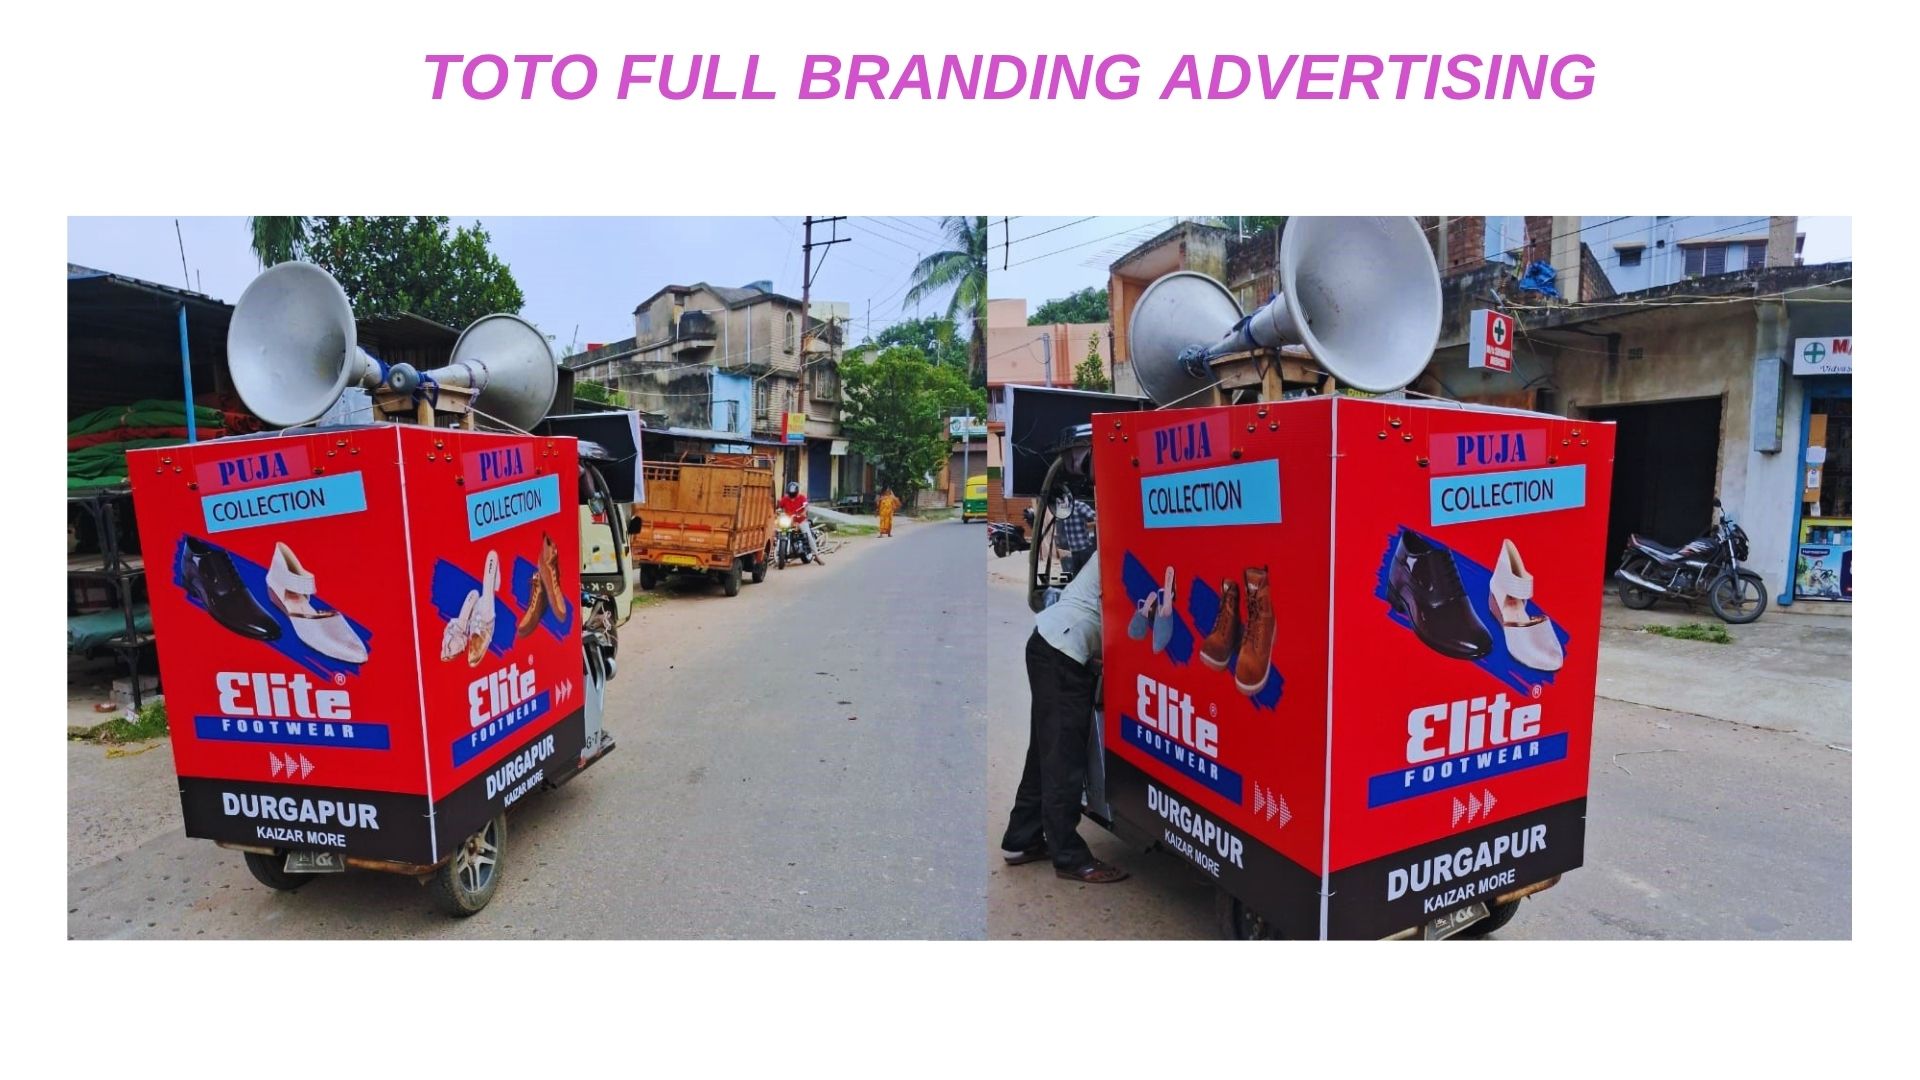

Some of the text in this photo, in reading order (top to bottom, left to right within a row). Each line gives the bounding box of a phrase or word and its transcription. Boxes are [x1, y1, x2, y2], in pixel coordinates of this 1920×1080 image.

[479, 447, 523, 481] PUJA
[1155, 421, 1211, 465] PUJA
[1456, 432, 1527, 466] PUJA
[218, 452, 288, 486] PUJA
[212, 487, 326, 522] COLLECTION
[474, 487, 542, 527] COLLECTION
[1148, 479, 1242, 515] COLLECTION
[1441, 478, 1554, 512] COLLECTION
[216, 671, 352, 720] Elite
[468, 662, 536, 728] Elite
[1137, 673, 1218, 759] Elite
[221, 718, 355, 739] FOOTWEAR
[471, 698, 537, 748] FOOTWEAR
[1406, 692, 1542, 764] Elite
[486, 734, 555, 801] DURGAPUR
[1137, 724, 1218, 781] FOOTWEAR
[1404, 741, 1539, 788] FOOTWEAR
[503, 768, 544, 808] KAIZAR MORE
[222, 792, 379, 830] DURGAPUR
[1148, 783, 1244, 870] DURGAPUR
[256, 825, 347, 848] KAIZAR MORE
[1164, 828, 1220, 878] KAIZAR MORE
[1387, 823, 1547, 902] DURGAPUR
[1423, 883, 1475, 914] KAIZAR
[1477, 868, 1516, 895] MORE
